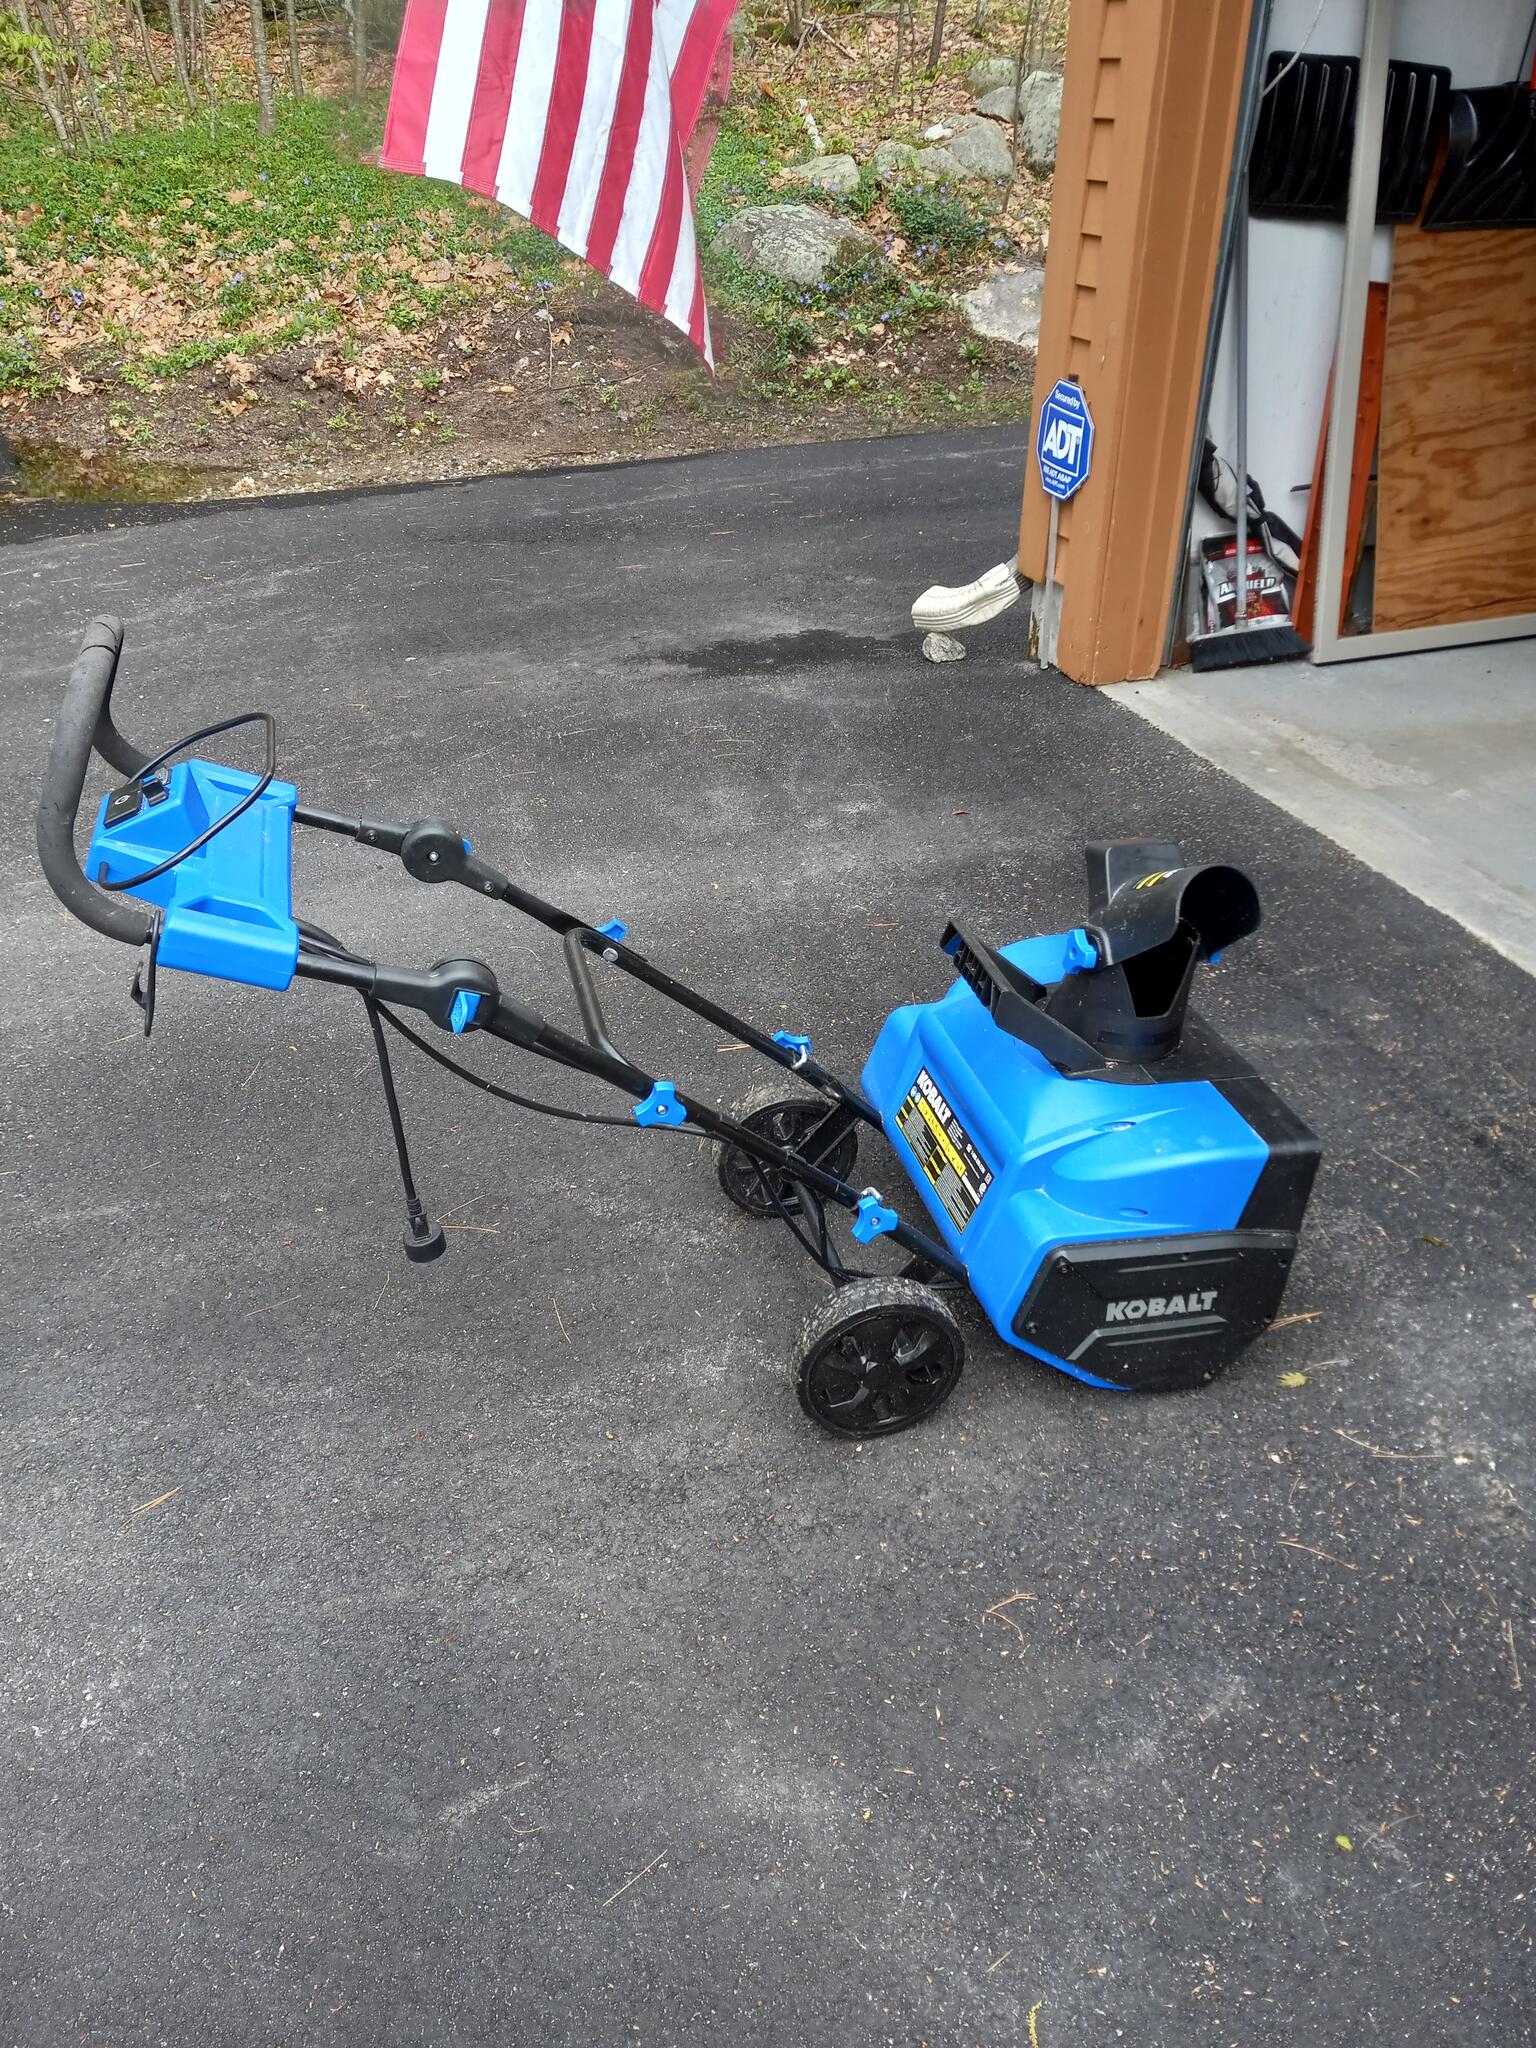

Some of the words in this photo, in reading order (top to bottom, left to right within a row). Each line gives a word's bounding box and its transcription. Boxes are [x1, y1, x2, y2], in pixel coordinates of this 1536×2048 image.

[1043, 418, 1082, 465] ADT
[917, 1069, 951, 1125] KOBALT
[1105, 1291, 1218, 1322] KOBALT
